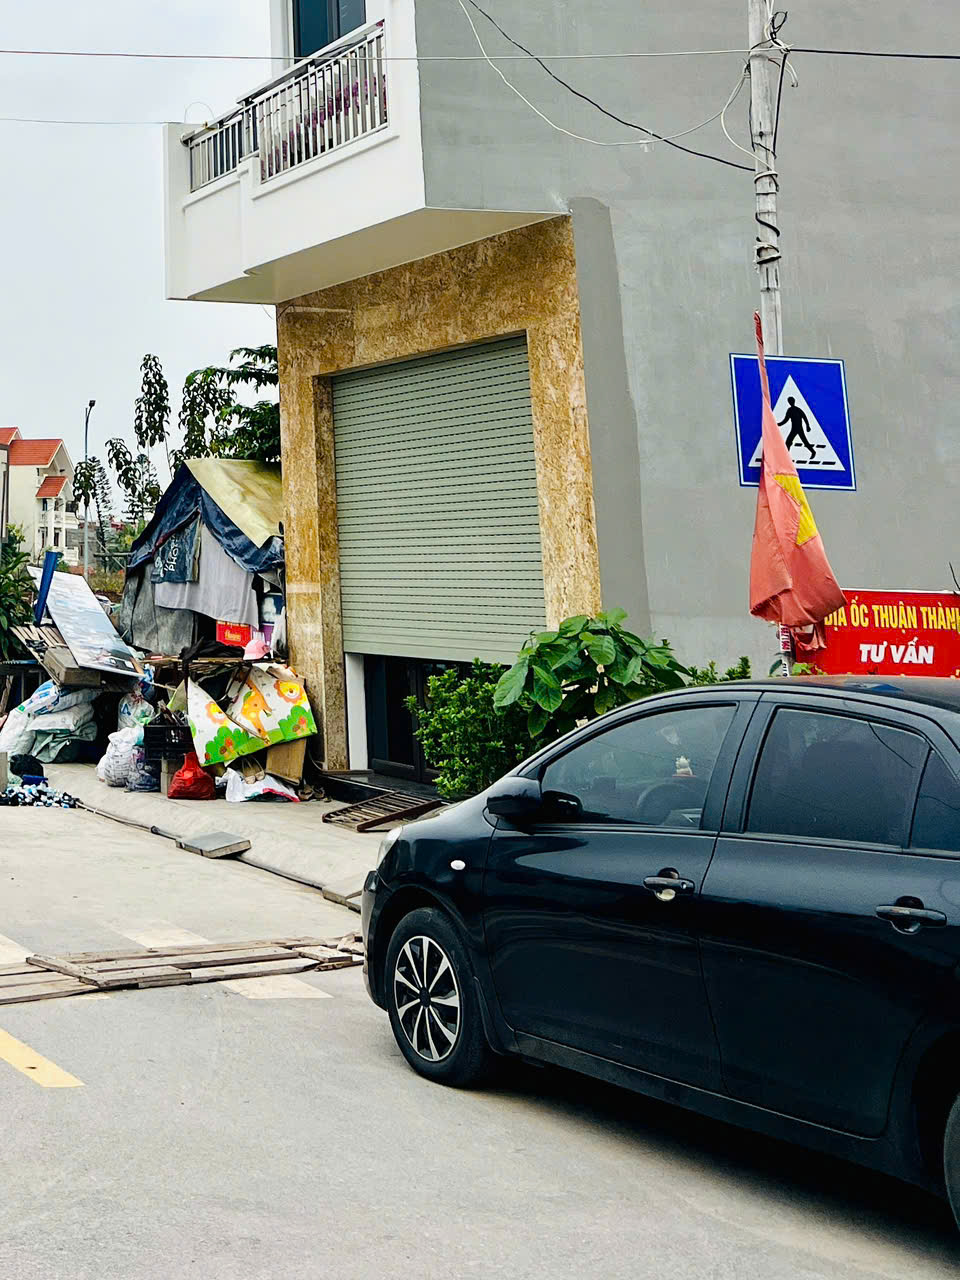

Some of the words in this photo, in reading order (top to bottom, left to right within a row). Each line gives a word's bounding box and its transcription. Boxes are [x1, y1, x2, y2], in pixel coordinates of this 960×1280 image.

[850, 595, 869, 628] ỐC
[871, 600, 918, 634] THUẬN
[859, 640, 888, 663] TƯ
[890, 636, 934, 664] VẤN
